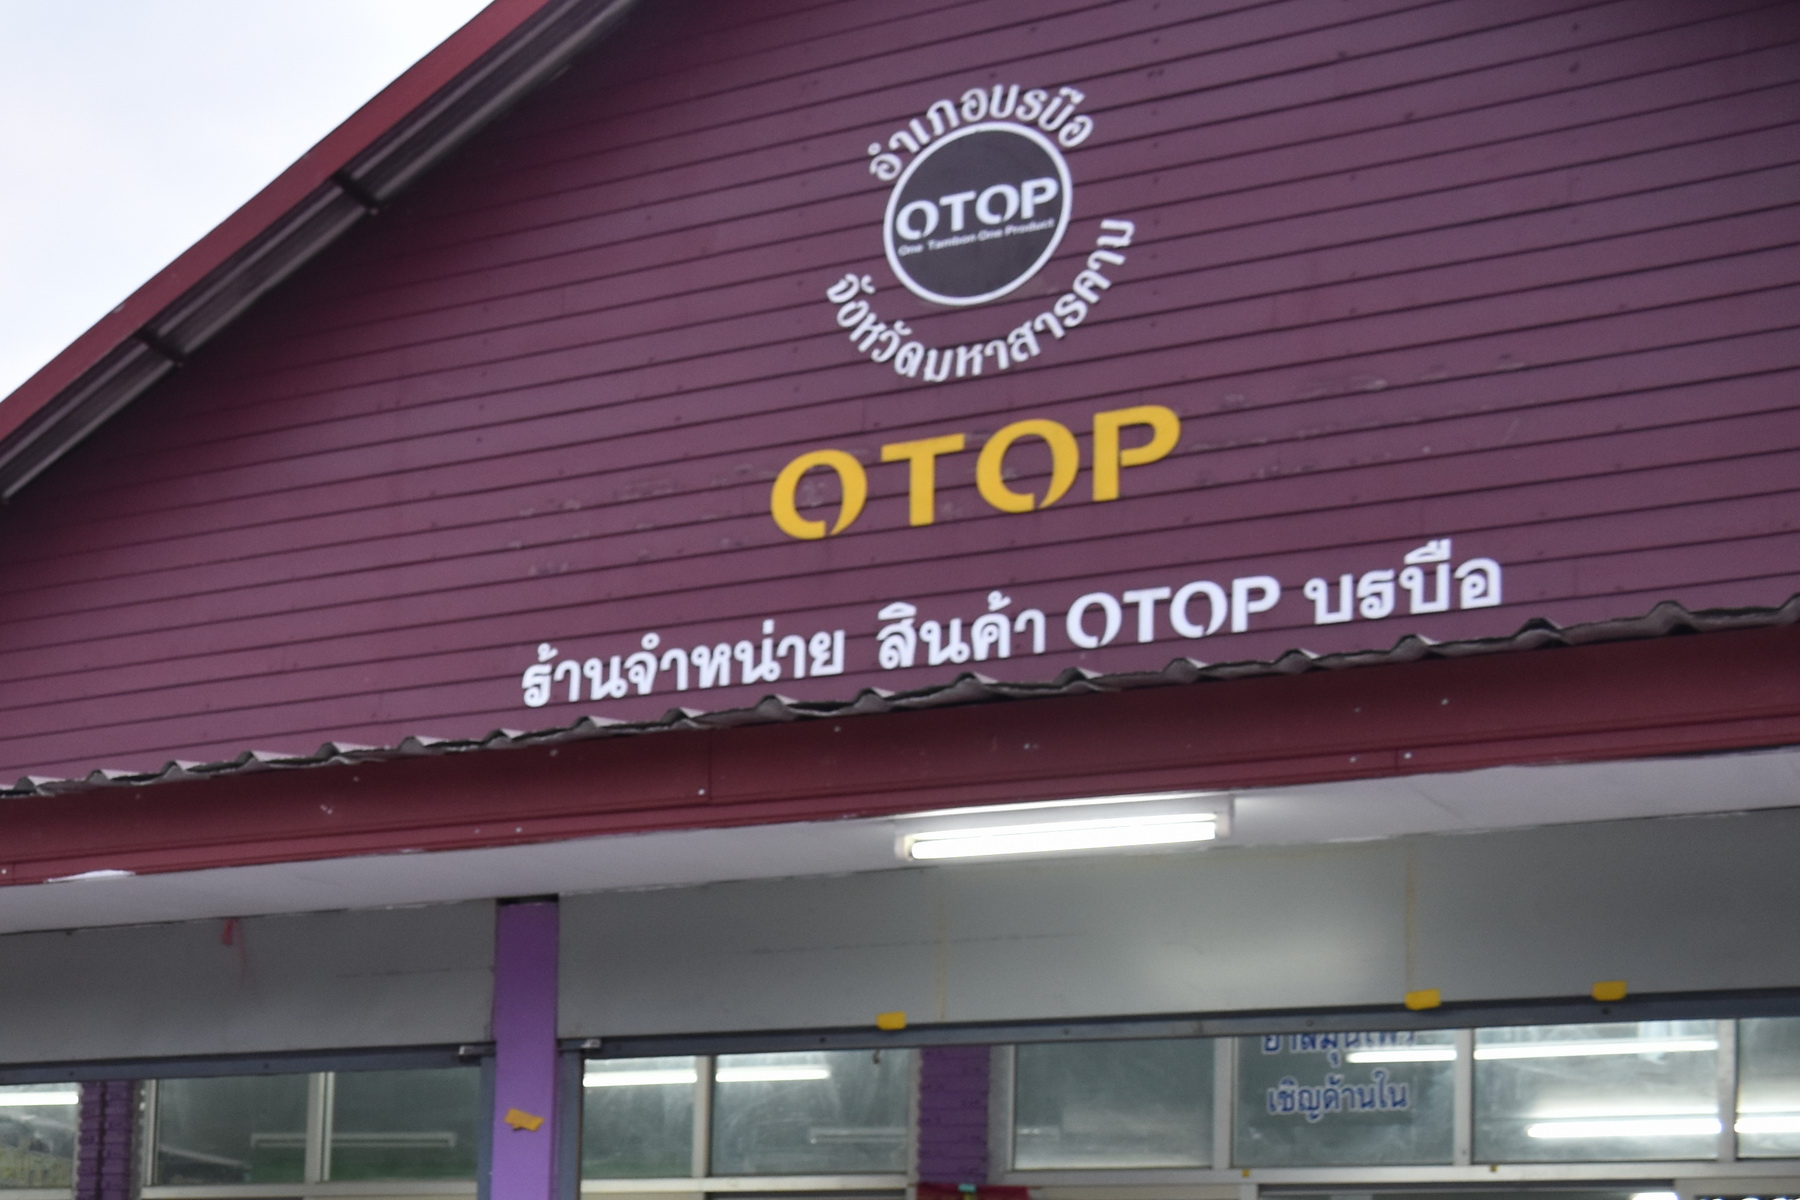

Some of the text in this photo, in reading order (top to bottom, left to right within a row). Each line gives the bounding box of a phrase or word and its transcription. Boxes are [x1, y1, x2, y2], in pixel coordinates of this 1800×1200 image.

[868, 83, 1094, 182] อำเภอบรบือ
[895, 176, 1060, 241] OTOP
[825, 217, 1136, 383] จังหวัดมหาสารคาม
[770, 404, 1181, 539] OTOP
[520, 538, 1504, 707] ร้านจำหน่าย สินค้า OTOP บรบือ
[1266, 1069, 1409, 1122] เชิญด้านใน
